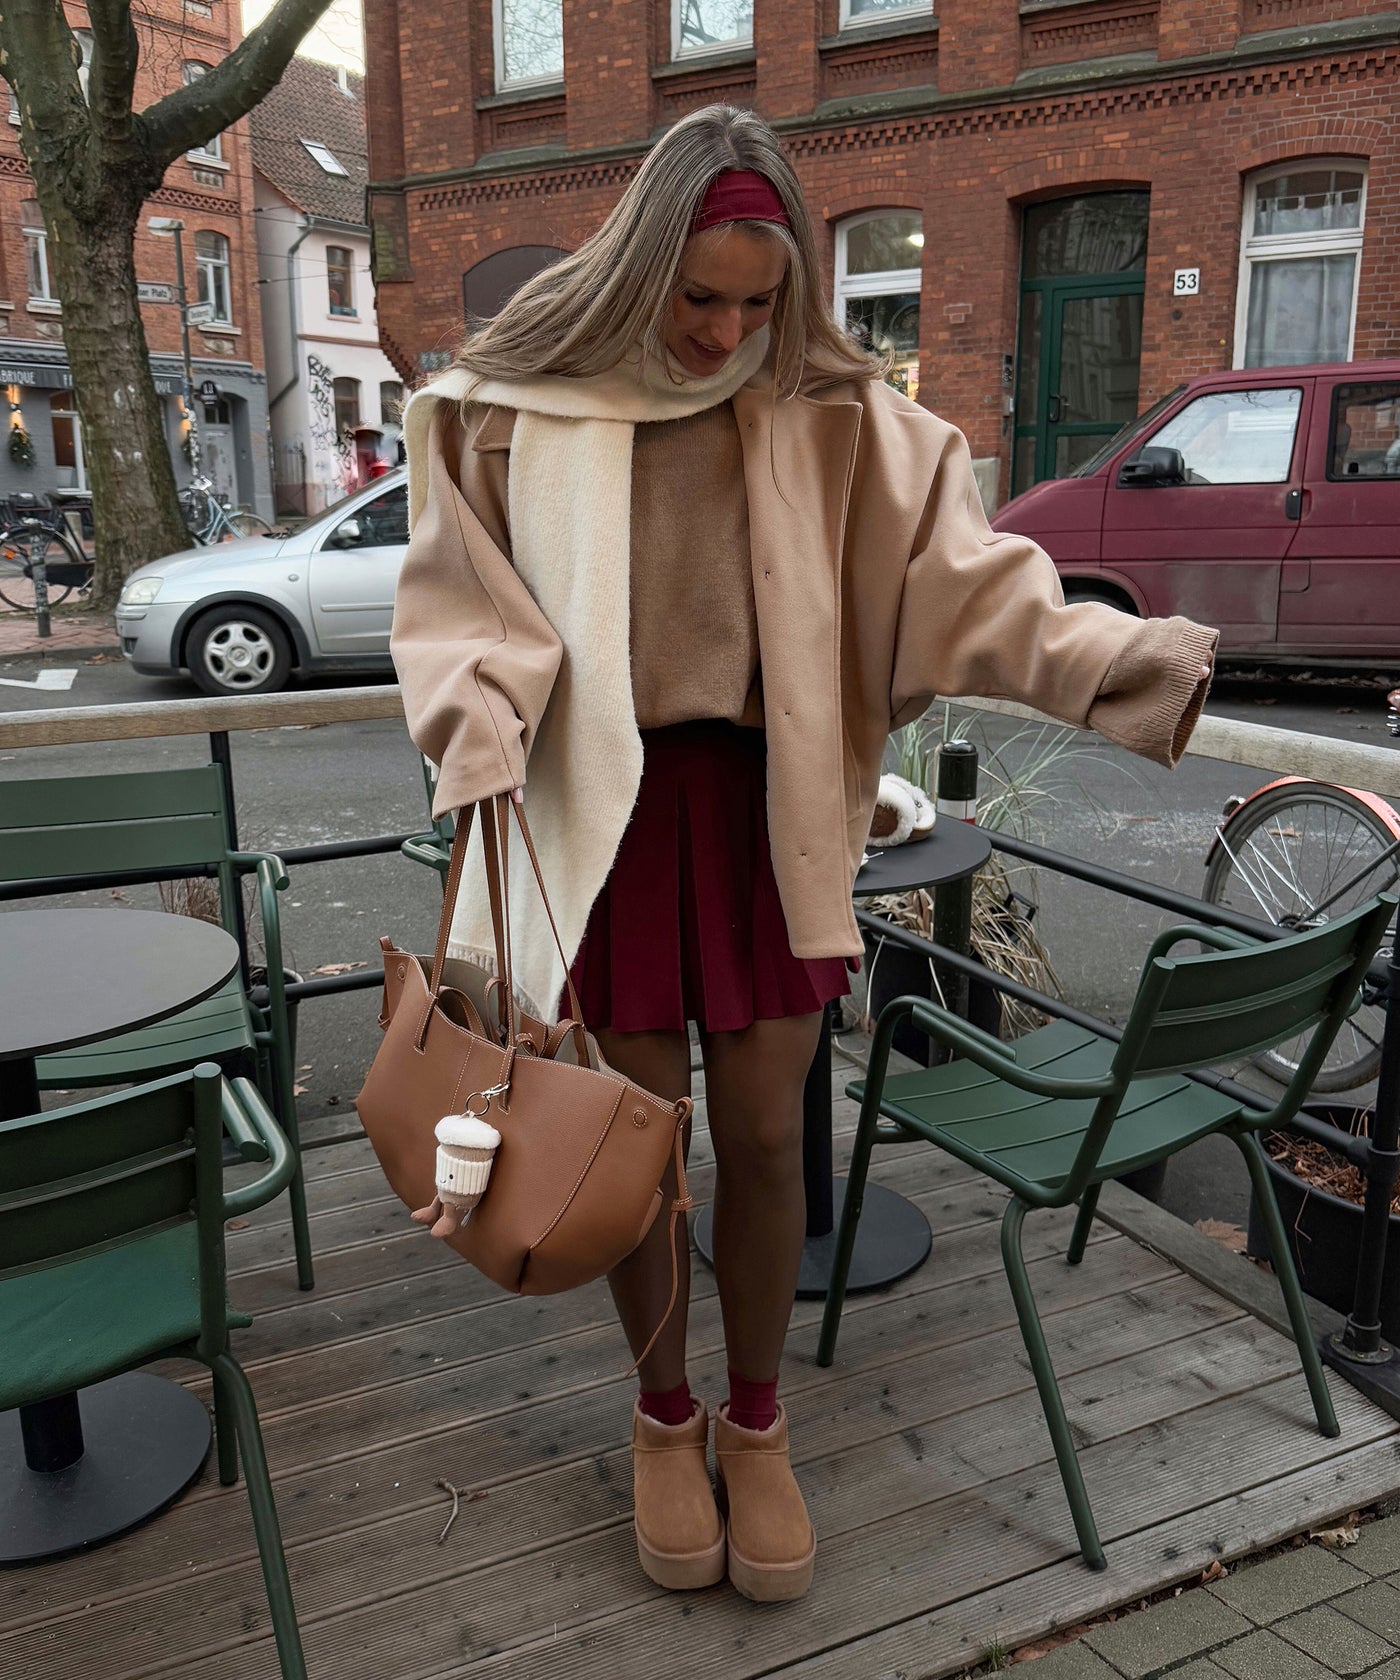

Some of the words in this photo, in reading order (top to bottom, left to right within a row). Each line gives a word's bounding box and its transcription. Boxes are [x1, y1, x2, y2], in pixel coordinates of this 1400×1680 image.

[1176, 273, 1197, 290] 53
[151, 288, 168, 298] Platz
[0, 369, 36, 385] BRIQUE
